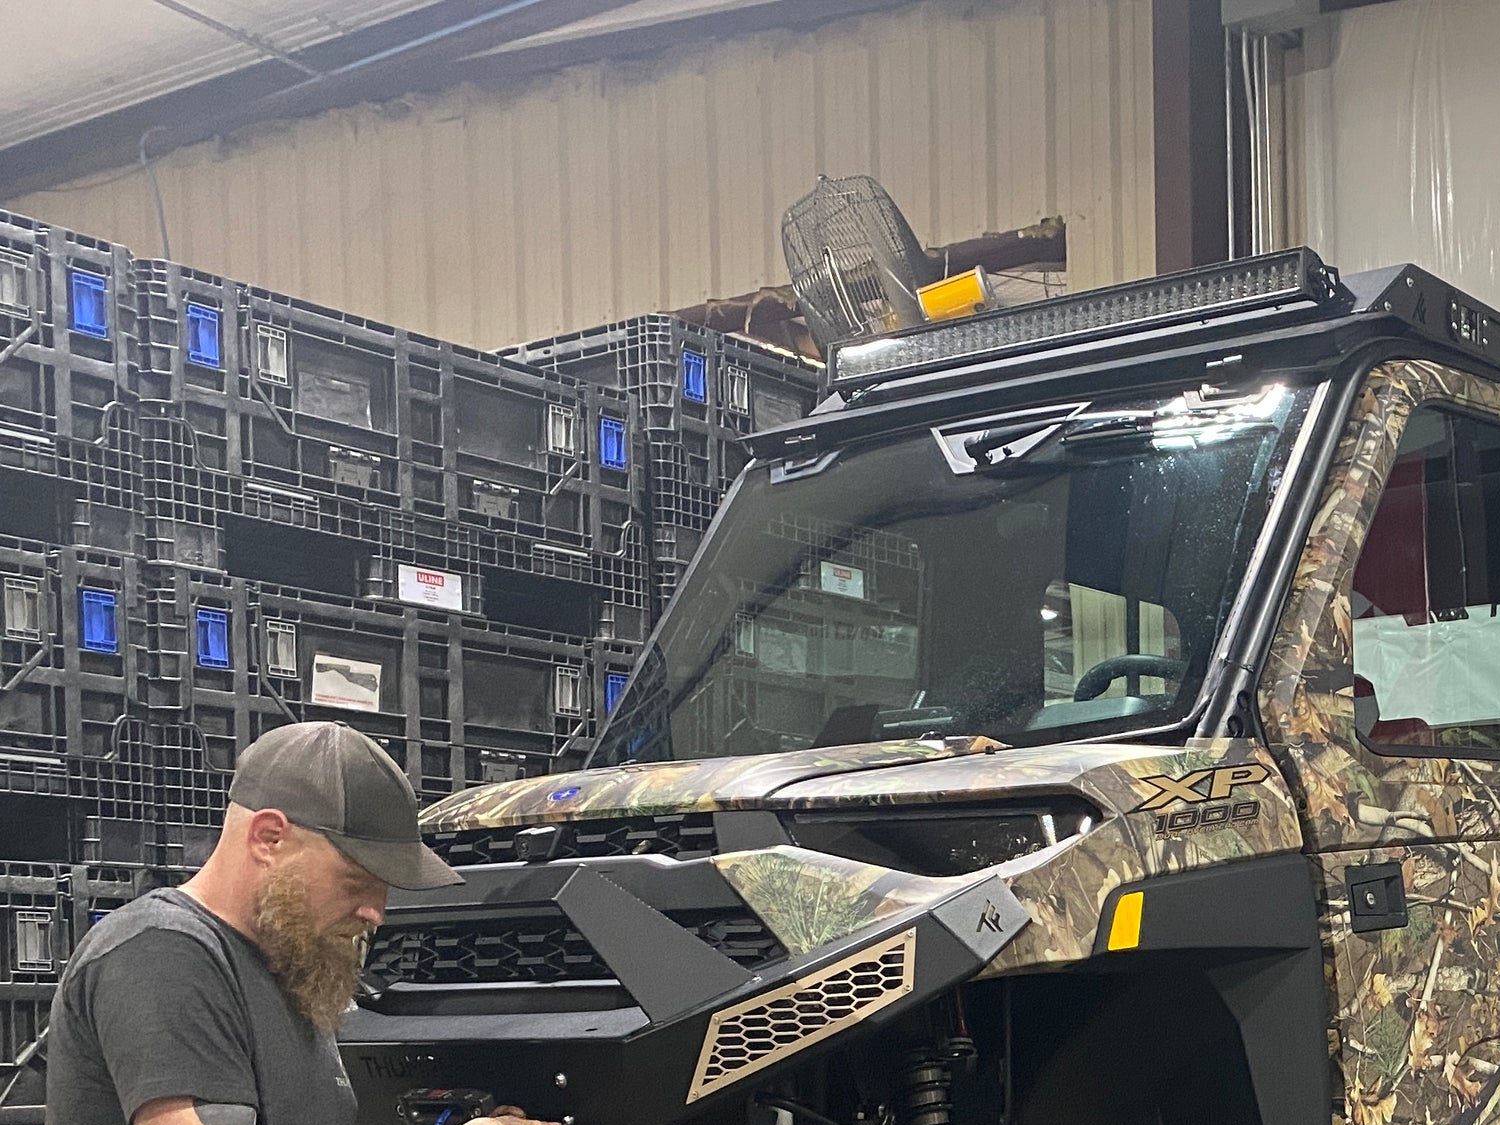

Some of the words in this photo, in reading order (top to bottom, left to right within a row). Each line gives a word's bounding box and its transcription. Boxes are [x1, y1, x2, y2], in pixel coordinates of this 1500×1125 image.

[417, 573, 444, 586] ULINE
[1124, 763, 1272, 815] XP
[1155, 801, 1261, 835] 1000
